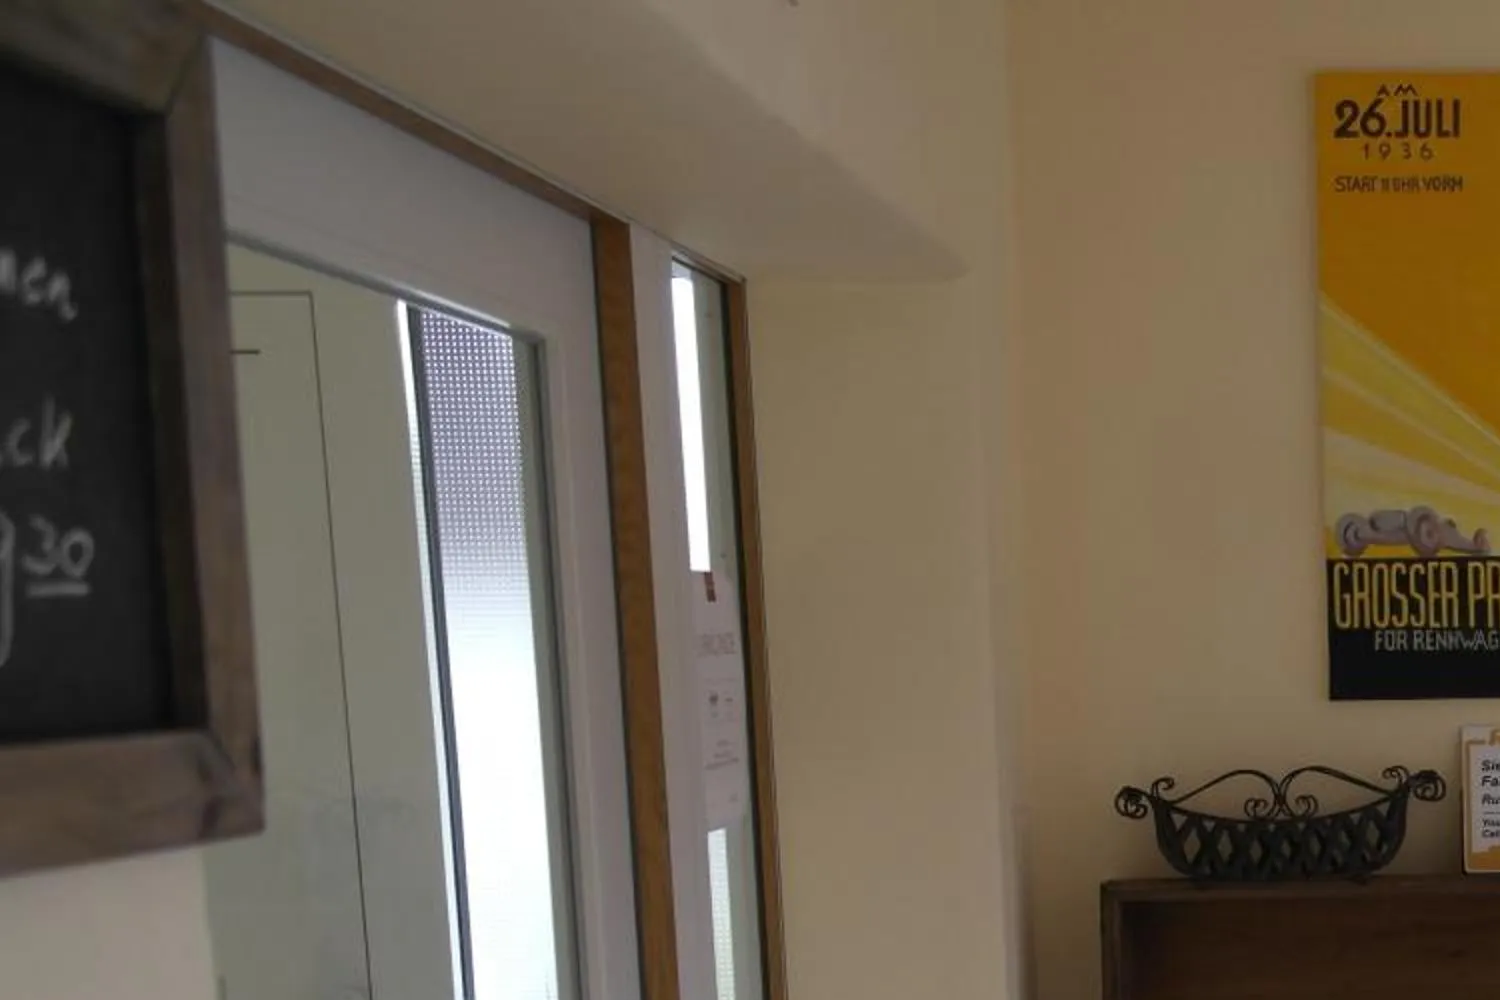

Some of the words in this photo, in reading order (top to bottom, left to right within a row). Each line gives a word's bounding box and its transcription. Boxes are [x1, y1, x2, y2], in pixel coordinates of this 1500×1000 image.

[1377, 83, 1419, 97] AM
[1363, 142, 1434, 160] 1936
[1334, 176, 1378, 193] START
[1333, 560, 1460, 629] GROSSER
